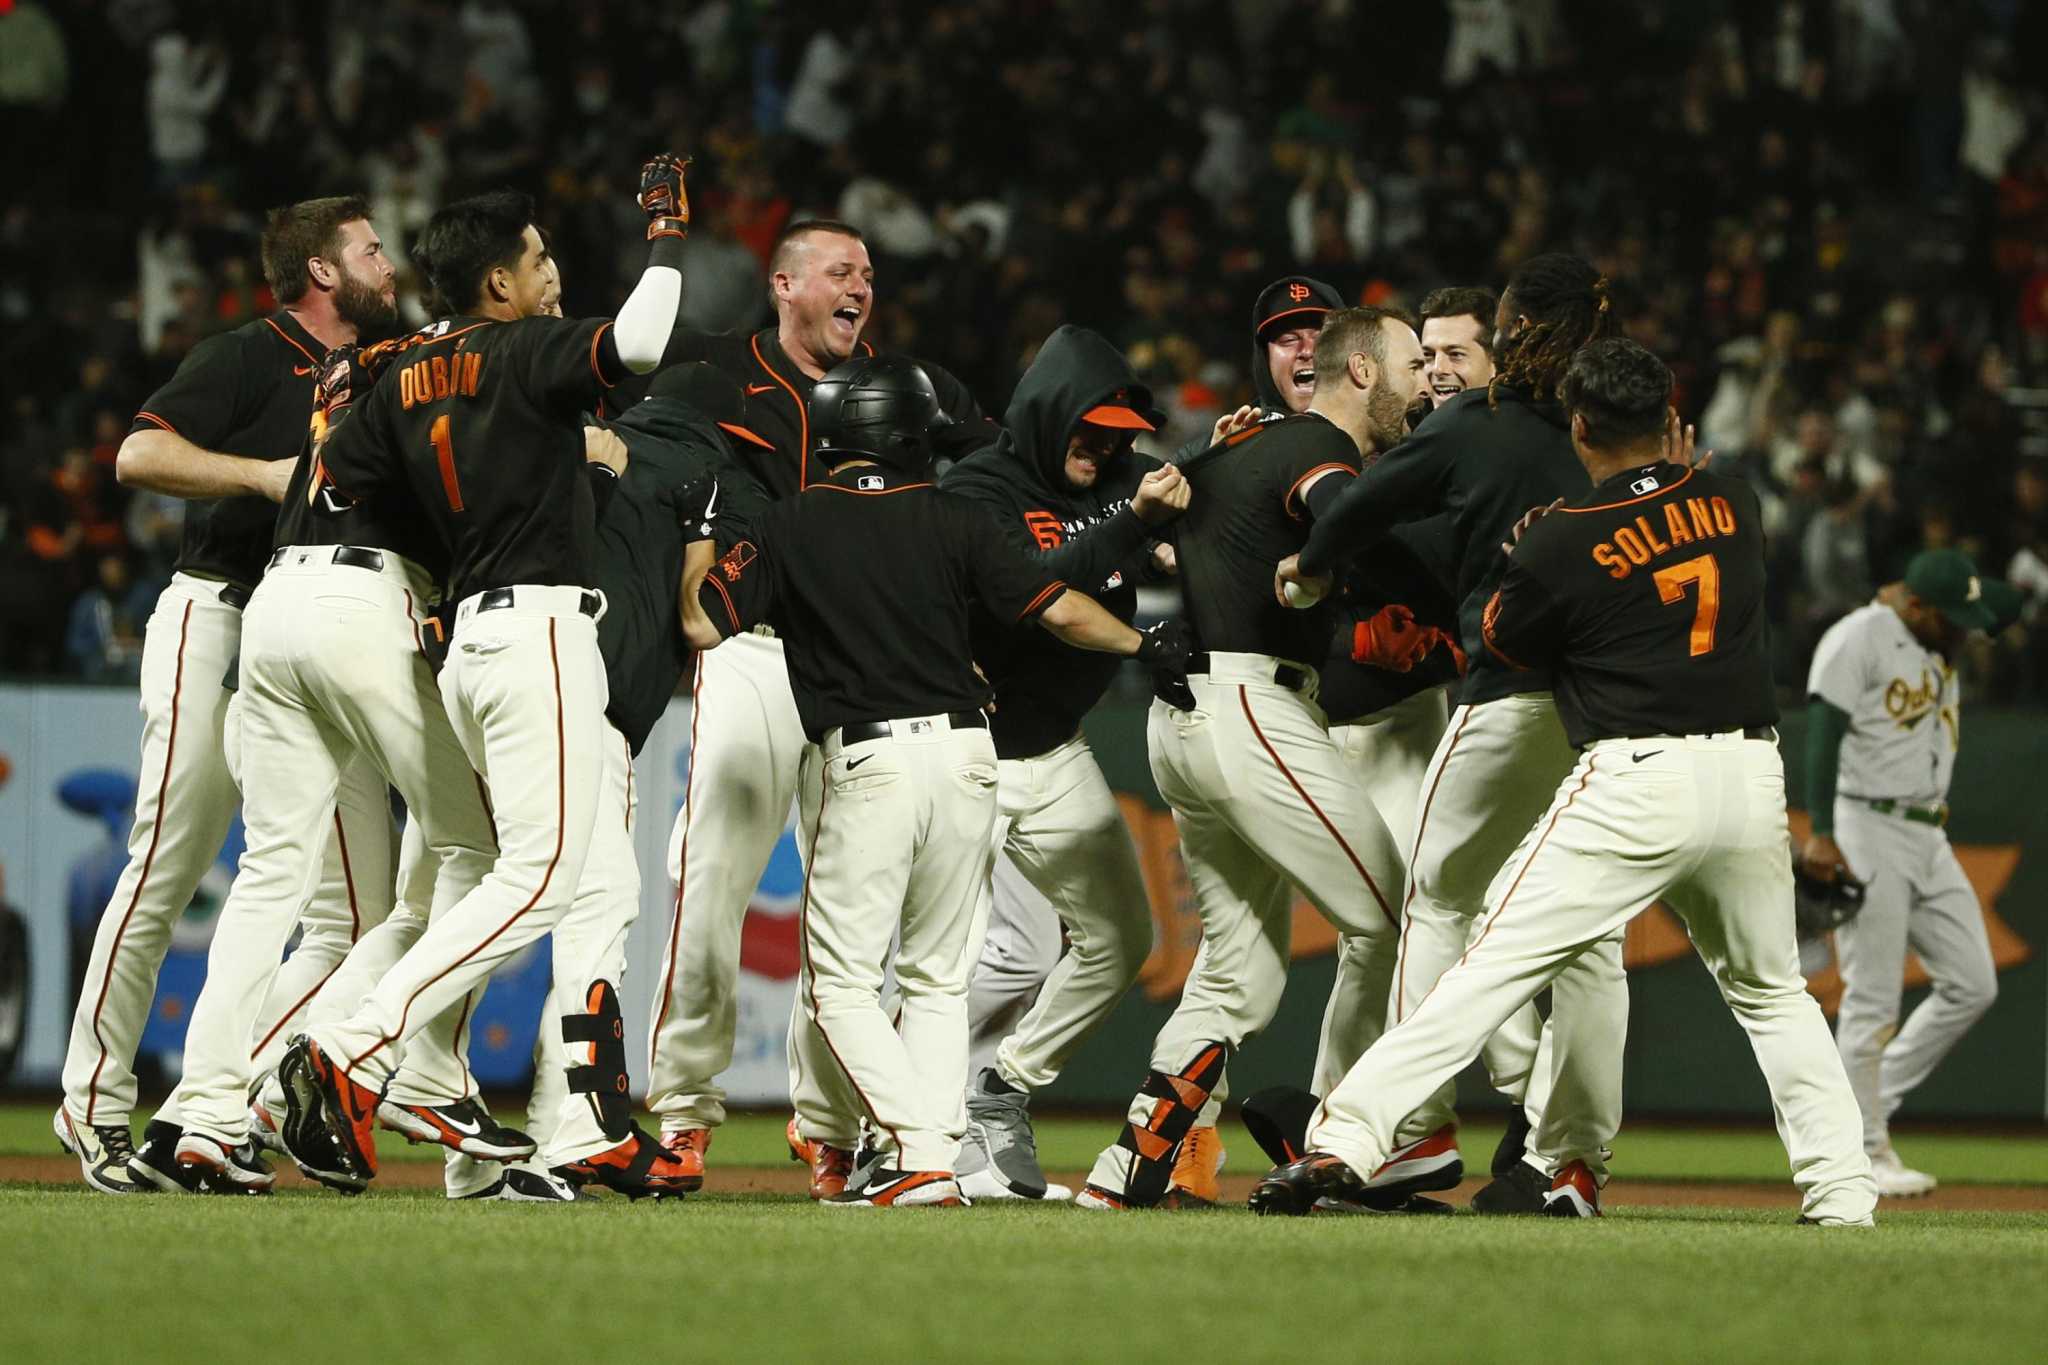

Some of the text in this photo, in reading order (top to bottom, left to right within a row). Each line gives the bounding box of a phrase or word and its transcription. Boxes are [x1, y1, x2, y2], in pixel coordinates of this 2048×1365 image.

[430, 415, 465, 513] 1
[1592, 495, 1736, 580] SOLANO
[1652, 553, 1720, 657] 7
